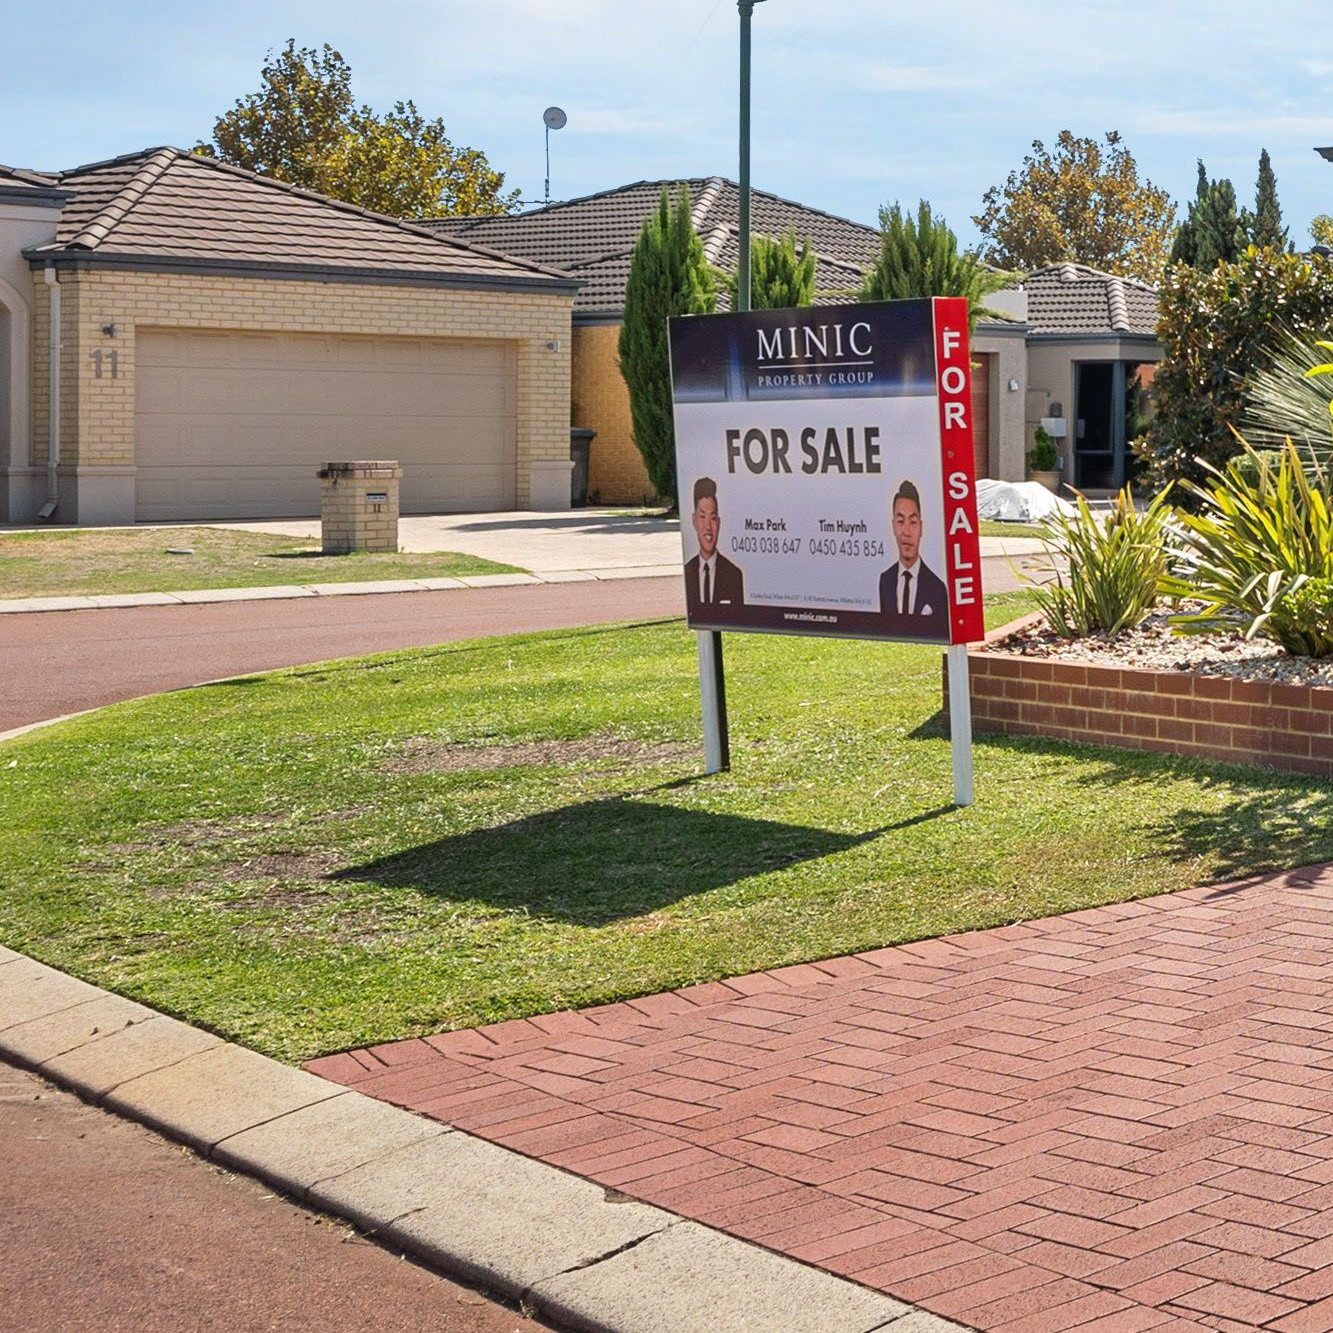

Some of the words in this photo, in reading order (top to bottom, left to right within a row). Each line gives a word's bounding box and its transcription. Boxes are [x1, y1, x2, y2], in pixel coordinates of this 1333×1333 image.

[757, 322, 872, 360] MINIC
[89, 349, 118, 378] 11
[758, 373, 822, 387] PROPERTY
[828, 371, 874, 385] GROUP
[942, 330, 967, 430] FOR
[725, 428, 792, 474] FOR
[801, 427, 882, 474] SALE
[744, 518, 765, 531] Max
[766, 518, 787, 532] Park
[818, 519, 834, 533] Tim
[836, 519, 867, 536] Huynh
[731, 536, 757, 553] 0403
[760, 537, 779, 554] 038
[782, 538, 801, 554] 647
[809, 538, 837, 555] 0450
[839, 539, 860, 556] 435
[863, 540, 885, 557] 854
[948, 471, 974, 606] SALE
